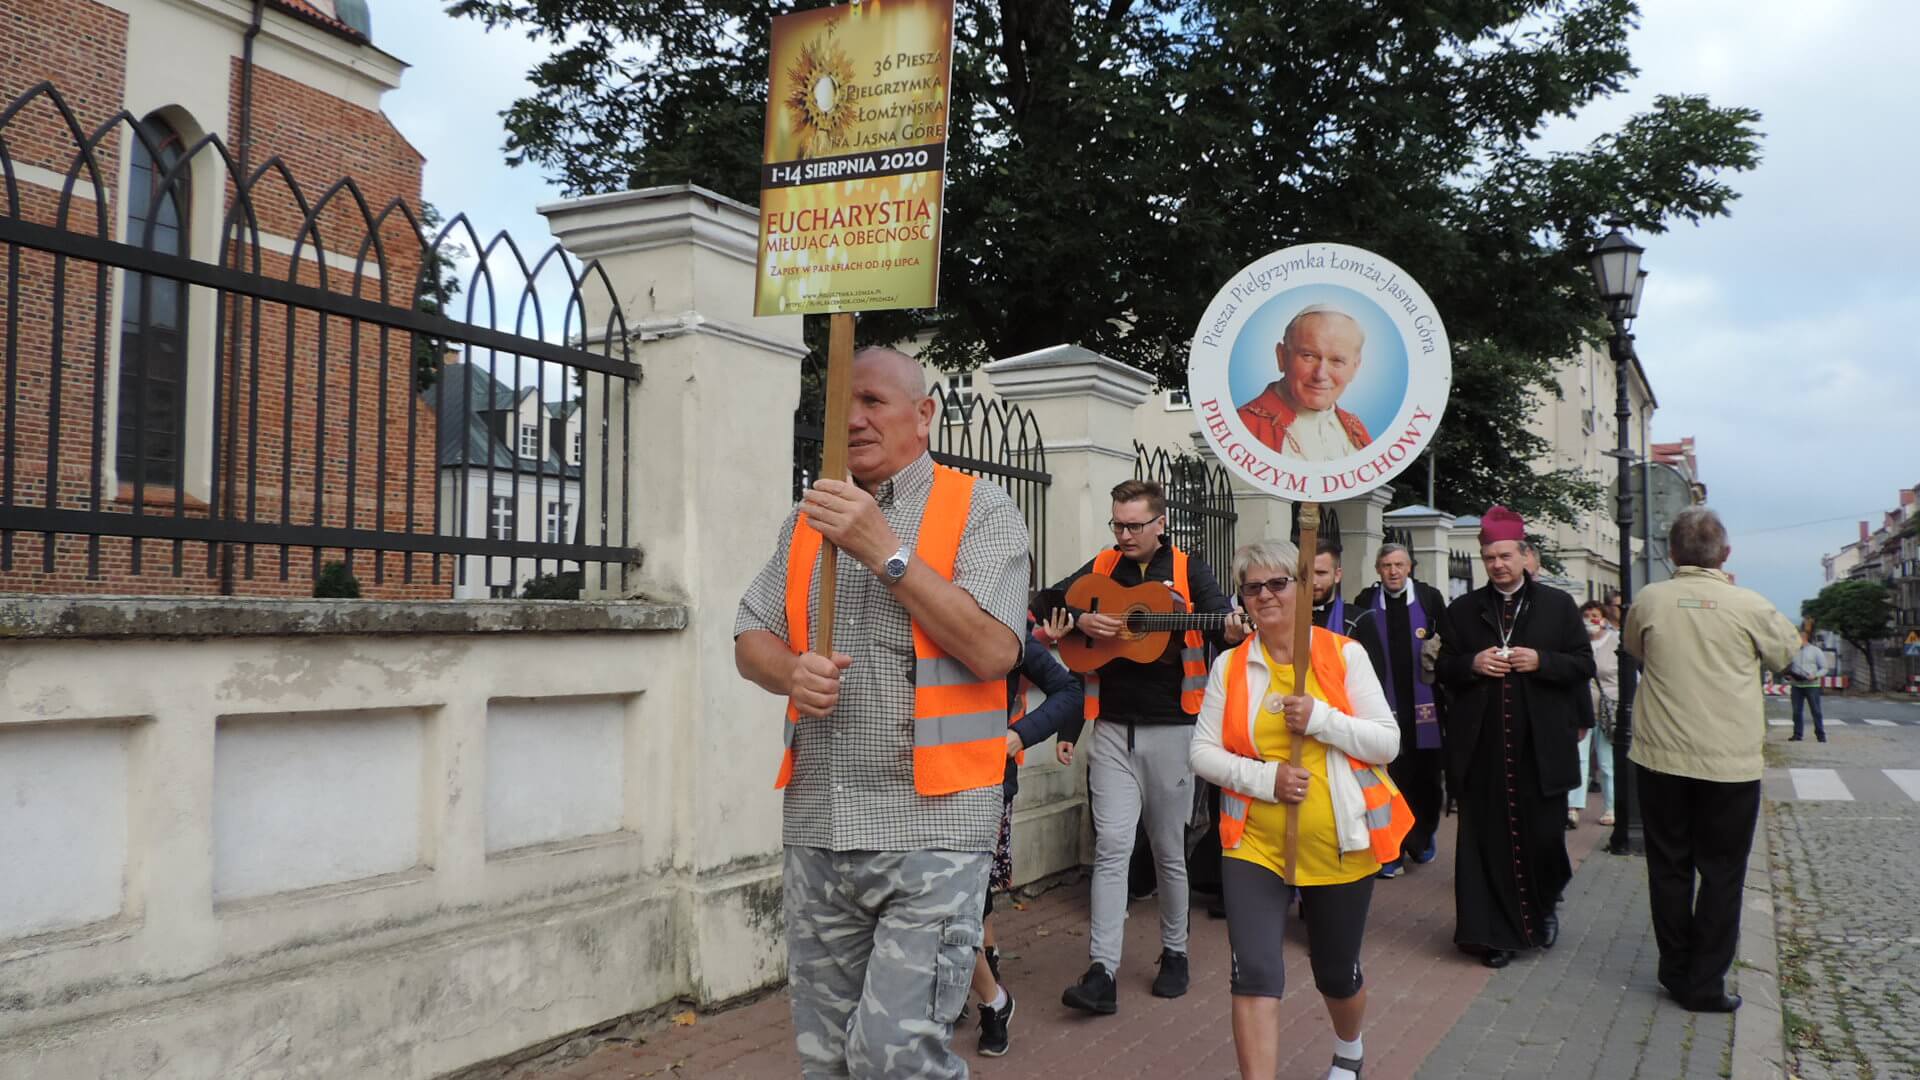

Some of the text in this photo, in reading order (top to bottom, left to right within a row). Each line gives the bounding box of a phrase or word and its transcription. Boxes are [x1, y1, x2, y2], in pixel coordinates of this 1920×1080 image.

[873, 50, 943, 78] 36 PIESZA
[847, 77, 941, 100] PIELGRZYMKA
[832, 137, 849, 148] NA
[804, 157, 876, 179] SIERPNIA
[880, 151, 928, 170] 2020
[767, 198, 931, 234] EUCHARYSTIA
[766, 221, 930, 254] MIŁUJĄCA OBECNOŚĆ
[770, 265, 800, 276] ZAPISY
[813, 261, 863, 273] PARAFIACH
[865, 260, 879, 270] OD
[881, 259, 892, 271] 19
[894, 257, 920, 267] LIPCA
[1203, 249, 1437, 355] Piesza Pielgrzymka Łomża-Jasna Góra
[1200, 397, 1433, 494] PIELGRZYM DUCHOWY
